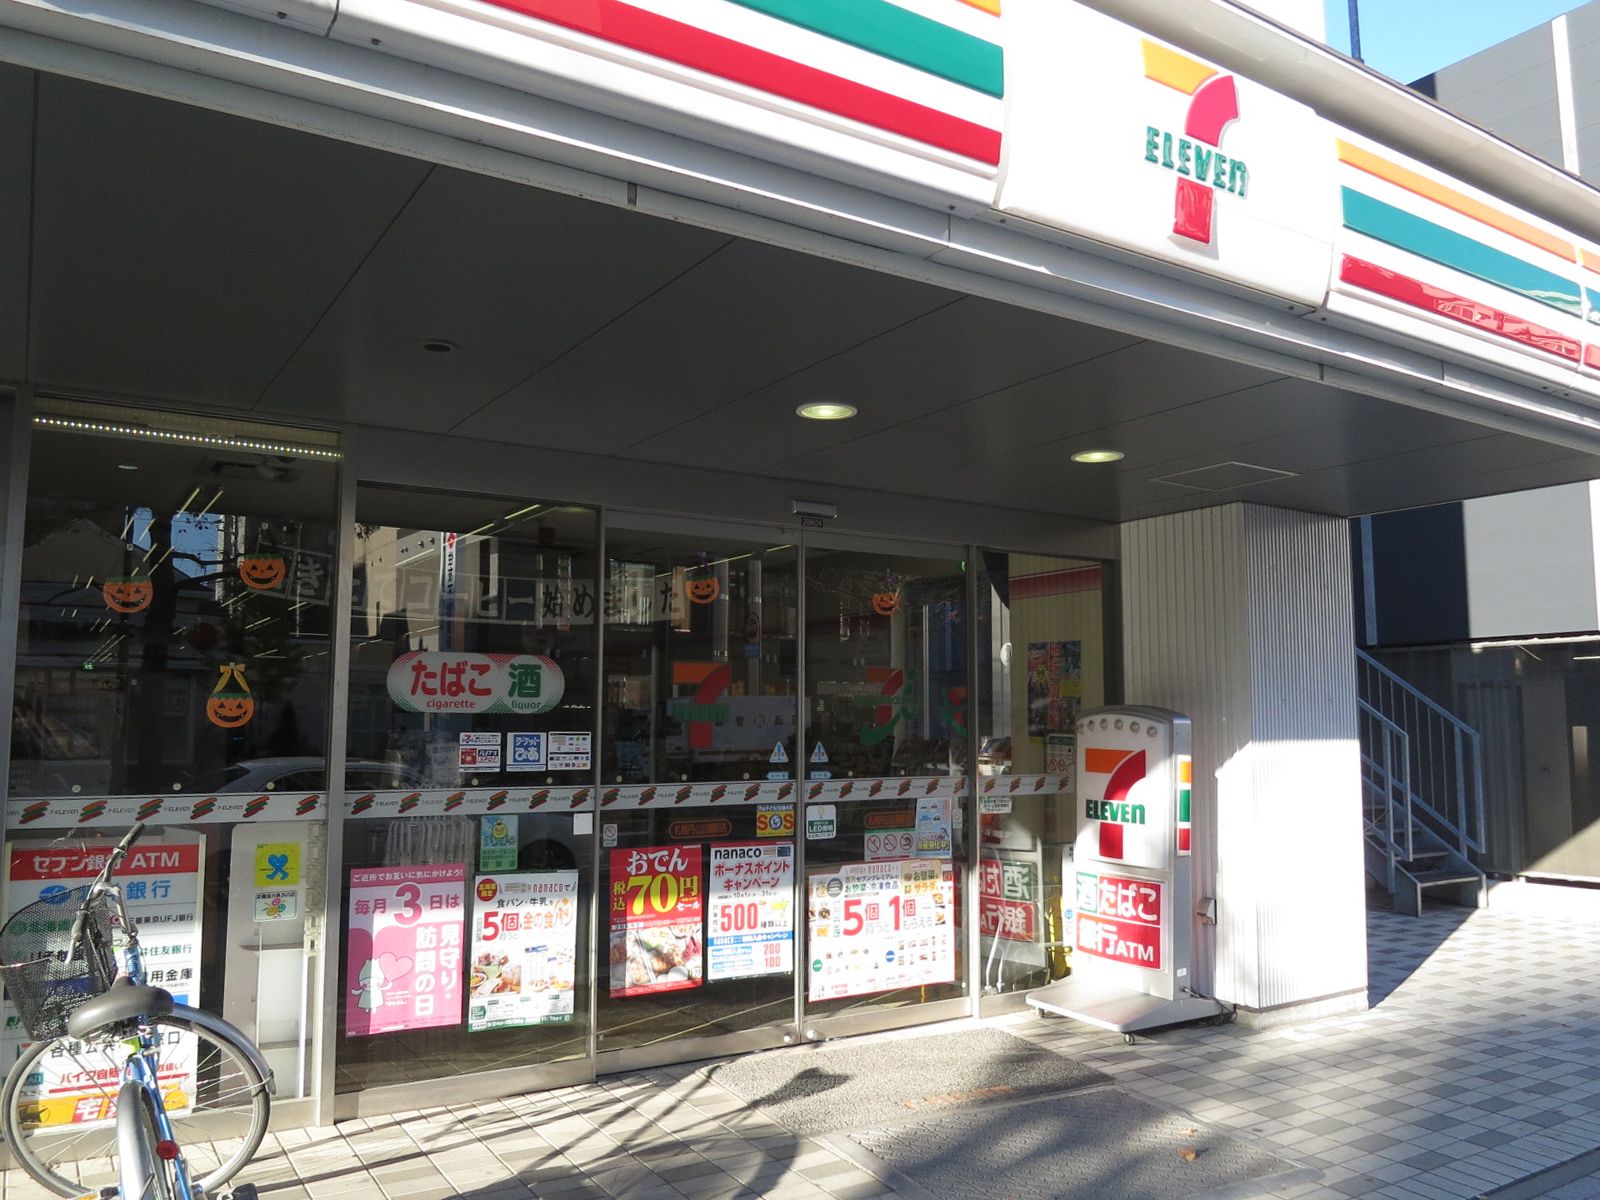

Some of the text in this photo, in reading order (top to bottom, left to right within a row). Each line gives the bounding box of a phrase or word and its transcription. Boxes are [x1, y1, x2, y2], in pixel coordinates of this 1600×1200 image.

[410, 659, 542, 698] たばこ 酒
[426, 699, 542, 710] cigarette liquor
[130, 852, 180, 869] ATM
[626, 847, 688, 876] おでん
[714, 847, 762, 860] nanaco
[714, 860, 790, 877] ボーナスポイント
[627, 872, 698, 915] 70円
[723, 877, 780, 891] キャンペーン
[613, 881, 626, 911] 税込
[1100, 879, 1158, 921] たばこ
[720, 902, 758, 932] 500
[140, 944, 192, 956] 井住友銀行
[145, 967, 193, 983] 用金庫
[415, 926, 437, 1016] 訪問の日
